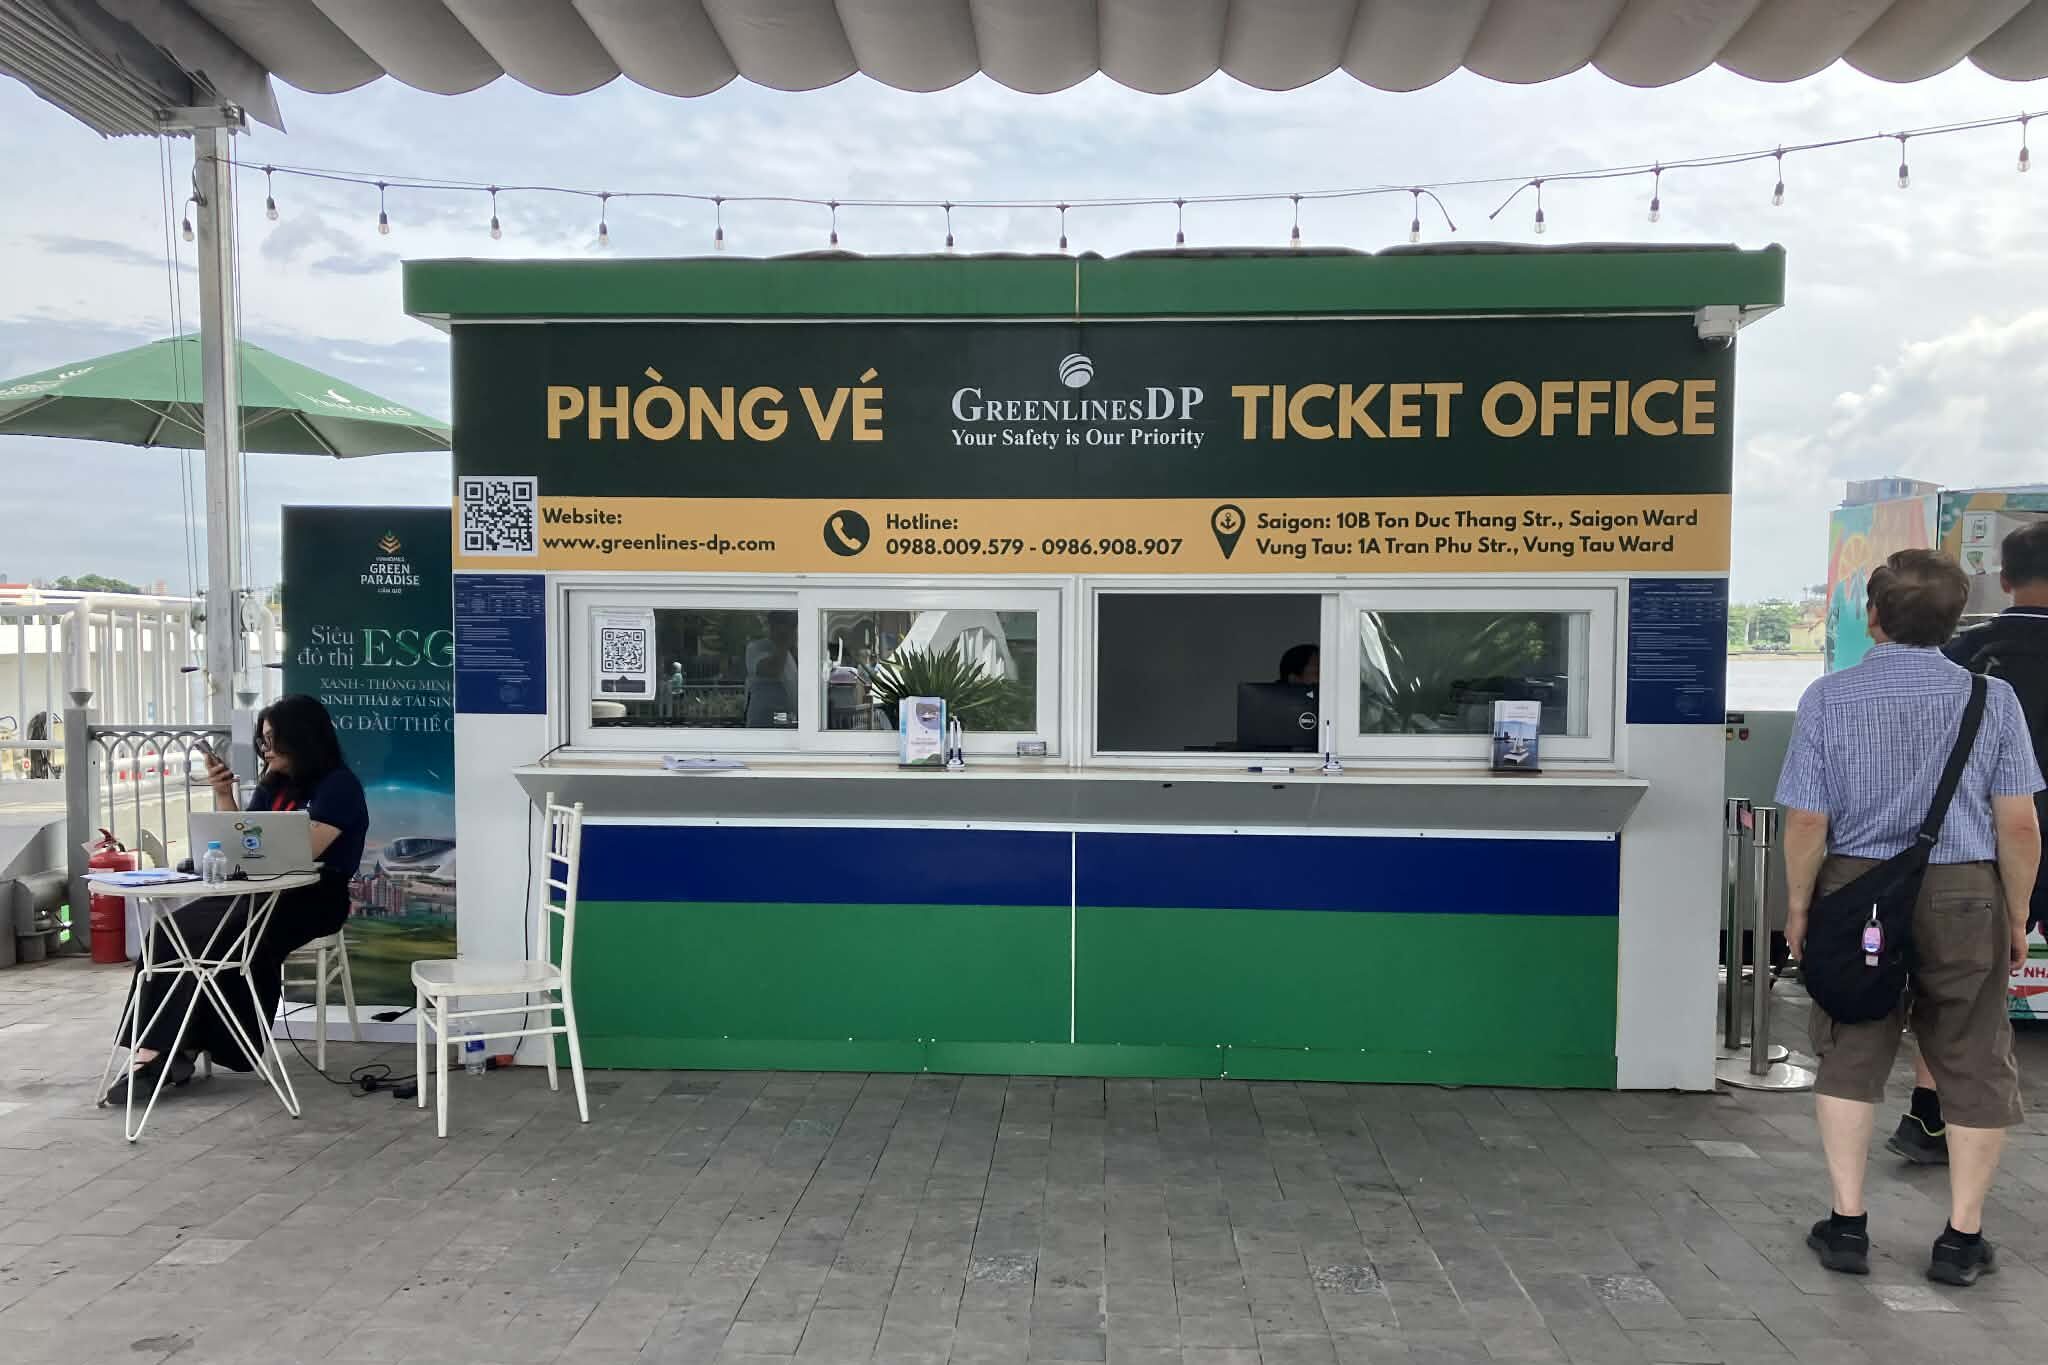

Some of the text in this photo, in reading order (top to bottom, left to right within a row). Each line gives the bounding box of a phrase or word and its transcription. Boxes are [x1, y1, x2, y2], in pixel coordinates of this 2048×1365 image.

[547, 367, 884, 442] PHÒNG VÉ
[1231, 379, 1717, 440] TICKET OFFICE
[951, 427, 1206, 450] Your Safety is Our Priority
[542, 507, 622, 526] Website:
[886, 512, 958, 530] Hotline:
[1257, 508, 1698, 533] Saigon: 10B Ton Duc Thang Str., Saigon Ward
[542, 532, 776, 556] www.greenlines-dp.com
[886, 538, 1024, 556] 0988.009.579
[1041, 537, 1183, 556] 0986.908.907
[1255, 534, 1674, 559] Vung Tau: 1A Tran Phu Str., Vung Tau Ward
[360, 574, 421, 585] PARADISE
[369, 563, 411, 575] GREEN
[311, 624, 354, 645] Siêu
[297, 647, 353, 670] đô thị
[360, 628, 454, 667] ESG
[320, 677, 358, 690] XANH
[320, 694, 353, 705] SINH
[391, 697, 401, 706] &
